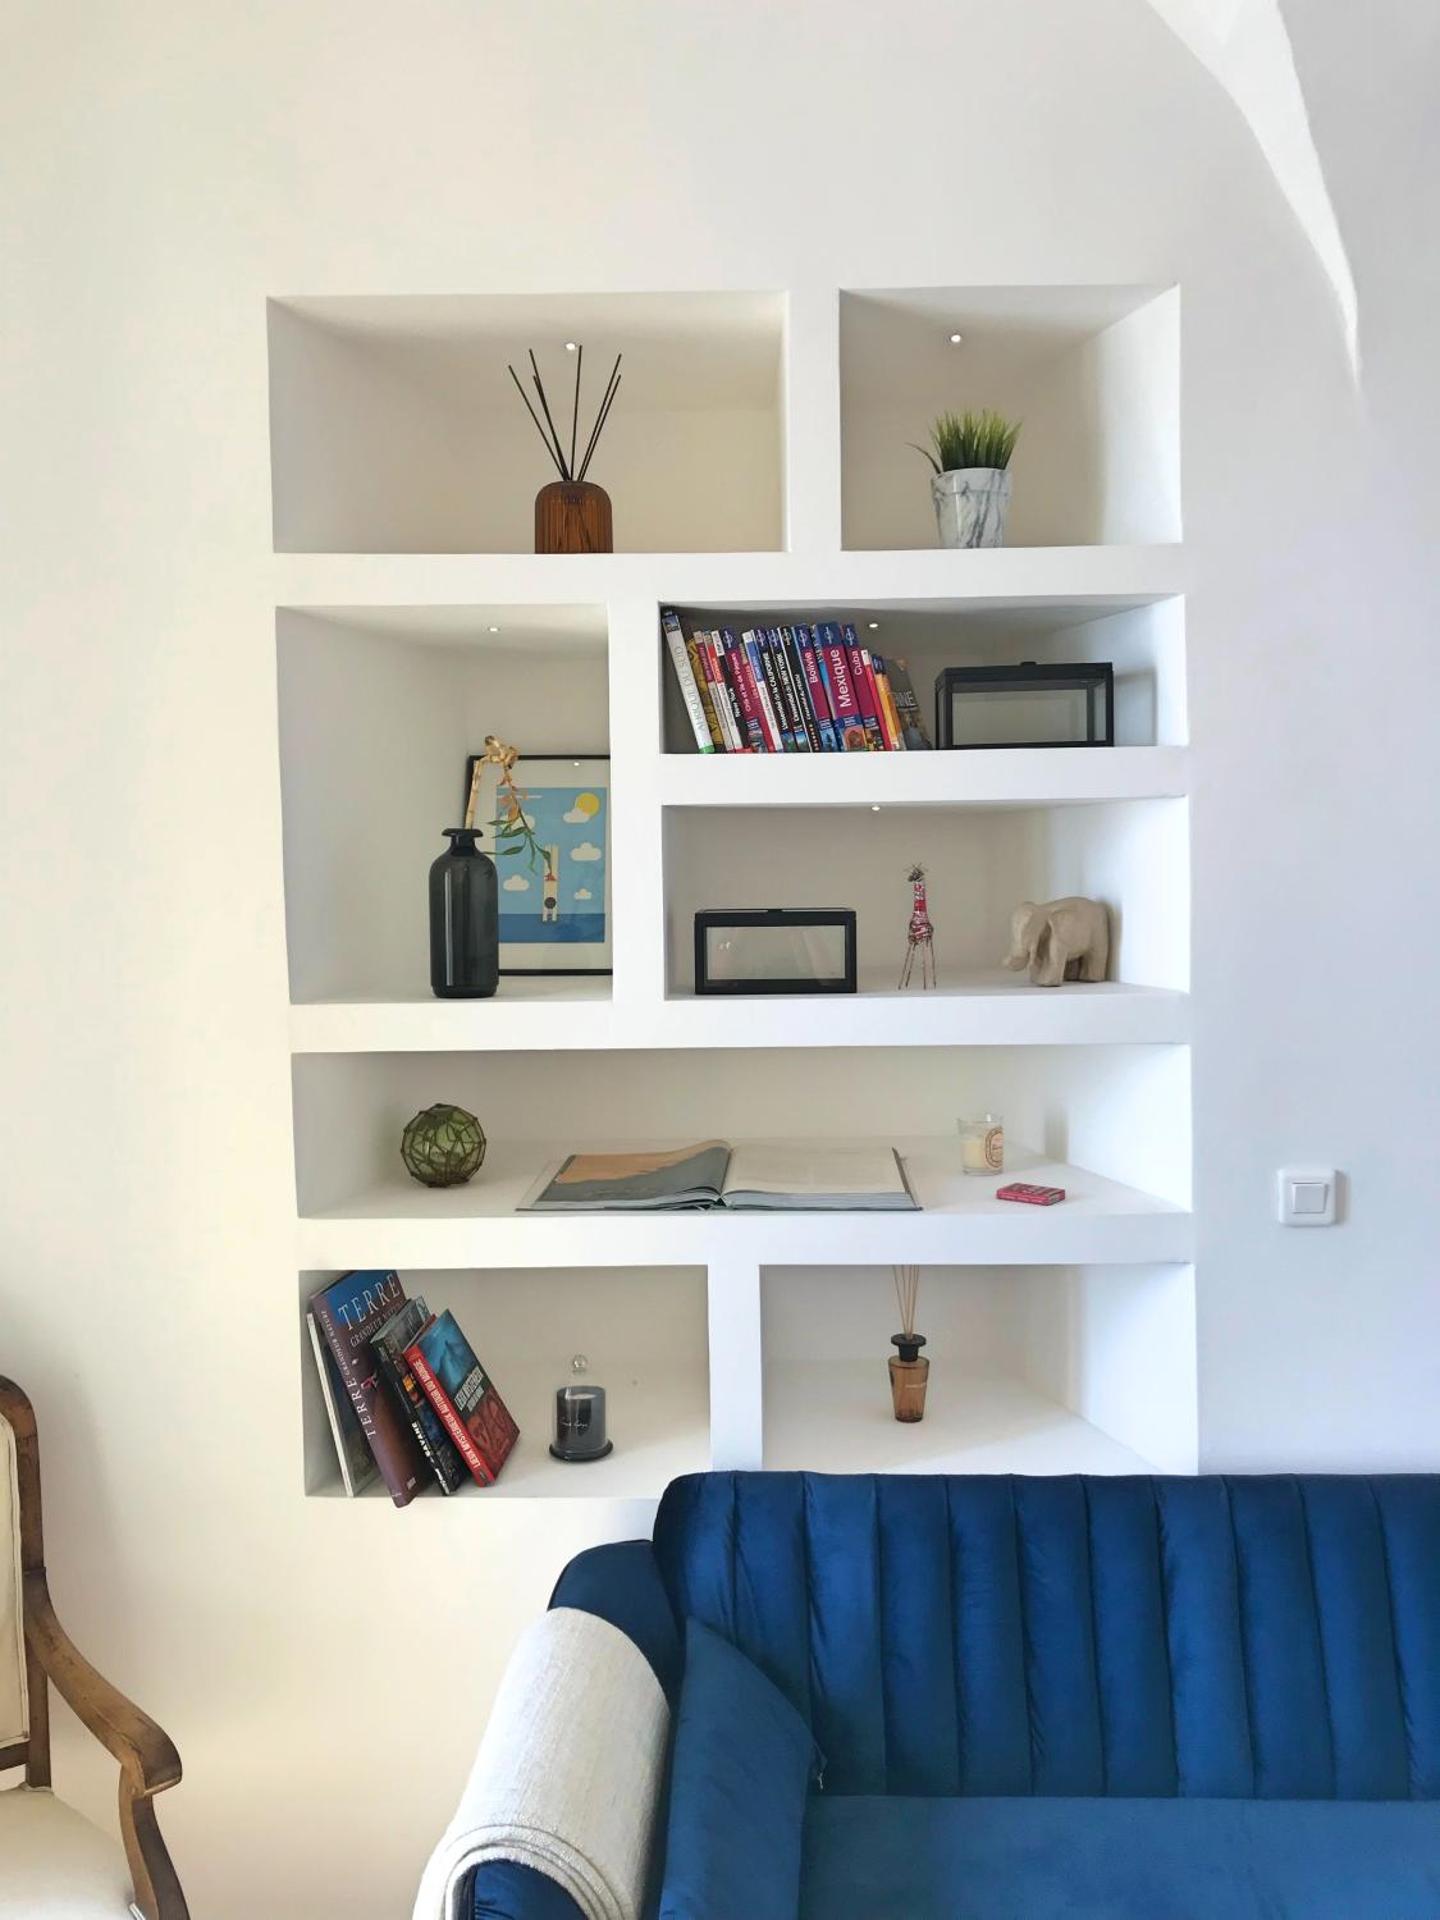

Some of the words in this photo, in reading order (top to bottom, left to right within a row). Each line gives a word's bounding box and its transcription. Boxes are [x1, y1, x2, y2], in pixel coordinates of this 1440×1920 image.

[802, 651, 818, 684] Bolivie
[849, 650, 863, 676] Cuba
[828, 648, 852, 709] Mexique
[728, 688, 736, 701] York
[733, 702, 741, 717] New
[338, 1274, 401, 1331] TERRE
[413, 1359, 431, 1382] MONDE
[425, 1380, 436, 1391] DU
[345, 1376, 377, 1439] TERRE
[430, 1389, 450, 1414] AUTOUR
[464, 1449, 481, 1469] LIEUX
